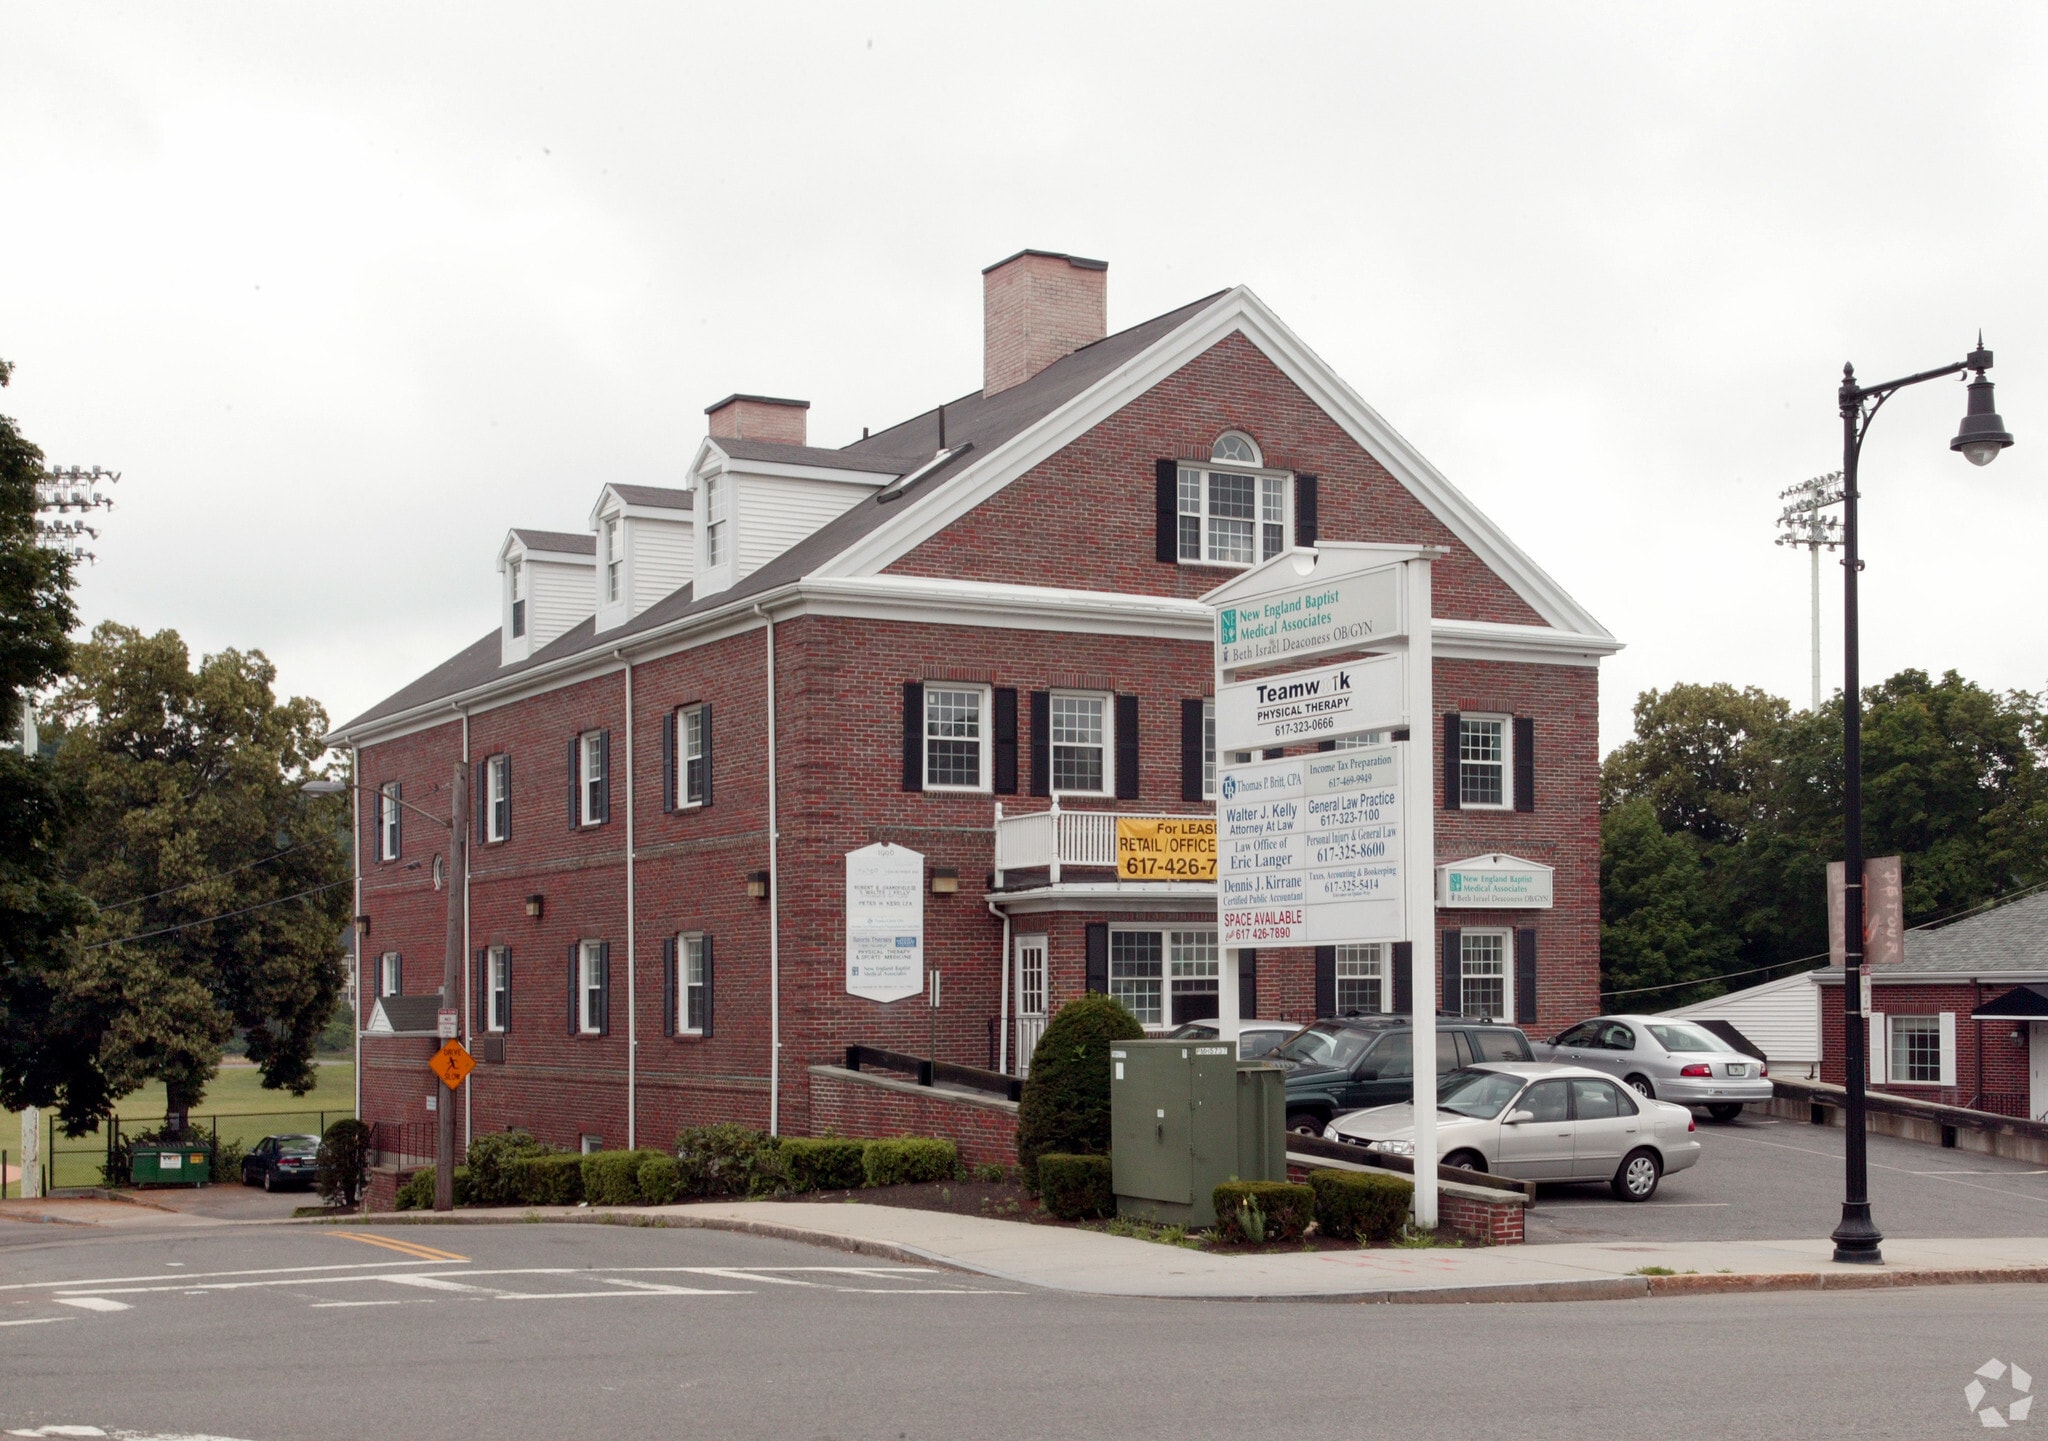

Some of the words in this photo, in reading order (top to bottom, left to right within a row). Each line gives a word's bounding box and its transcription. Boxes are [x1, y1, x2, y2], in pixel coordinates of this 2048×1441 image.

[1240, 610, 1260, 623] New
[1264, 597, 1301, 619] England
[1305, 590, 1339, 611] Baptist
[1240, 624, 1277, 641] Medical
[1281, 612, 1332, 632] Associates
[1233, 646, 1253, 661] Beth
[1255, 639, 1280, 657] Israel
[1283, 633, 1330, 651] Deaconess
[1257, 705, 1302, 721] PHYSICAL
[1305, 697, 1350, 713] THERAPY
[1275, 716, 1334, 736] 617-323-0666
[1310, 764, 1335, 774] Income
[1337, 760, 1349, 771] Tax
[1350, 755, 1392, 771] Preparation
[1237, 780, 1262, 793] Thomas
[1263, 777, 1269, 789] P.
[1270, 776, 1286, 789] Britt,
[1287, 772, 1302, 786] CPA
[1328, 773, 1372, 788] 617-469-9949
[1308, 796, 1339, 814] General
[1341, 795, 1358, 810] Law
[1360, 791, 1395, 807] Practice
[1226, 807, 1258, 823] Walter
[1260, 805, 1269, 819] J.
[1272, 802, 1297, 819] Kelly
[1320, 808, 1380, 826] 617-323-7100
[1157, 823, 1178, 834] For
[1230, 824, 1263, 836] Attorney
[1266, 820, 1275, 831] At
[1277, 820, 1294, 831] Law
[1306, 832, 1331, 846] Personal
[1332, 831, 1349, 846] Injury
[1351, 829, 1356, 841] &
[1358, 827, 1381, 840] General
[1383, 826, 1396, 838] Law
[1235, 841, 1250, 853] Law
[1253, 838, 1277, 851] Office
[1280, 836, 1288, 848] of
[1317, 841, 1385, 863] 617-325-8600
[1231, 855, 1252, 870] Eric
[1255, 853, 1293, 869] Langer
[1327, 869, 1356, 879] Accounting
[1357, 868, 1362, 877] &
[1481, 875, 1507, 884] England
[1509, 875, 1533, 883] Baptist
[1224, 878, 1253, 893] Dennis
[1255, 876, 1264, 892] J.
[1266, 875, 1302, 890] Kirrane
[1324, 878, 1378, 893] 617-325-5414
[1223, 896, 1248, 906] Certified
[1249, 894, 1267, 904] Public
[1270, 892, 1303, 903] Accountant
[1224, 912, 1252, 927] SPACE
[1254, 910, 1302, 926] AVAILABLE
[1235, 929, 1250, 940] 617
[1252, 927, 1290, 939] 426-7890
